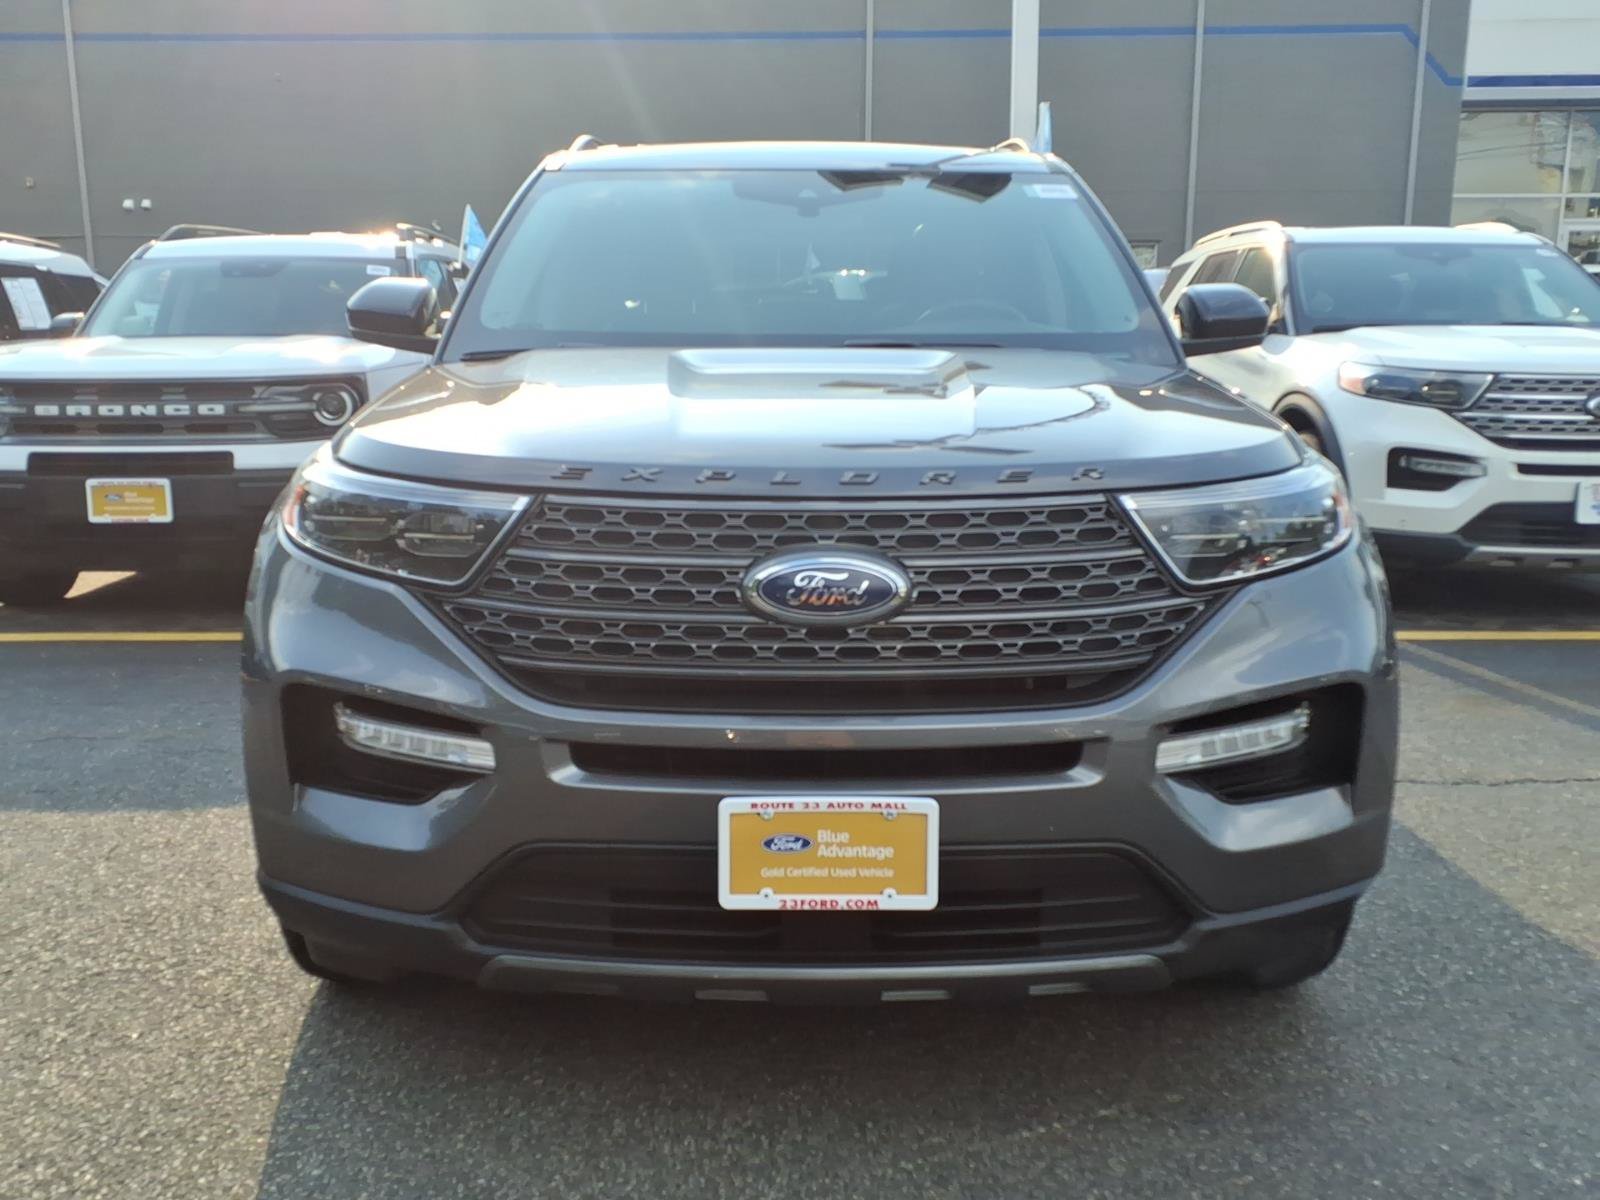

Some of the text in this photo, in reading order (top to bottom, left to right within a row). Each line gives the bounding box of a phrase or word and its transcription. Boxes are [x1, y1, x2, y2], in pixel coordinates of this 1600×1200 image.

[34, 404, 225, 416] BRONCO
[550, 464, 1106, 486] EXPLORER
[785, 570, 870, 607] Ford
[750, 802, 908, 811] ROUTE 23 AUTO MALL
[817, 829, 850, 843] Blue
[770, 835, 803, 852] Ford
[817, 844, 895, 860] Advantage
[760, 866, 895, 878] Gold Certified Used Vehicle
[778, 899, 880, 910] 23FORD.COM
